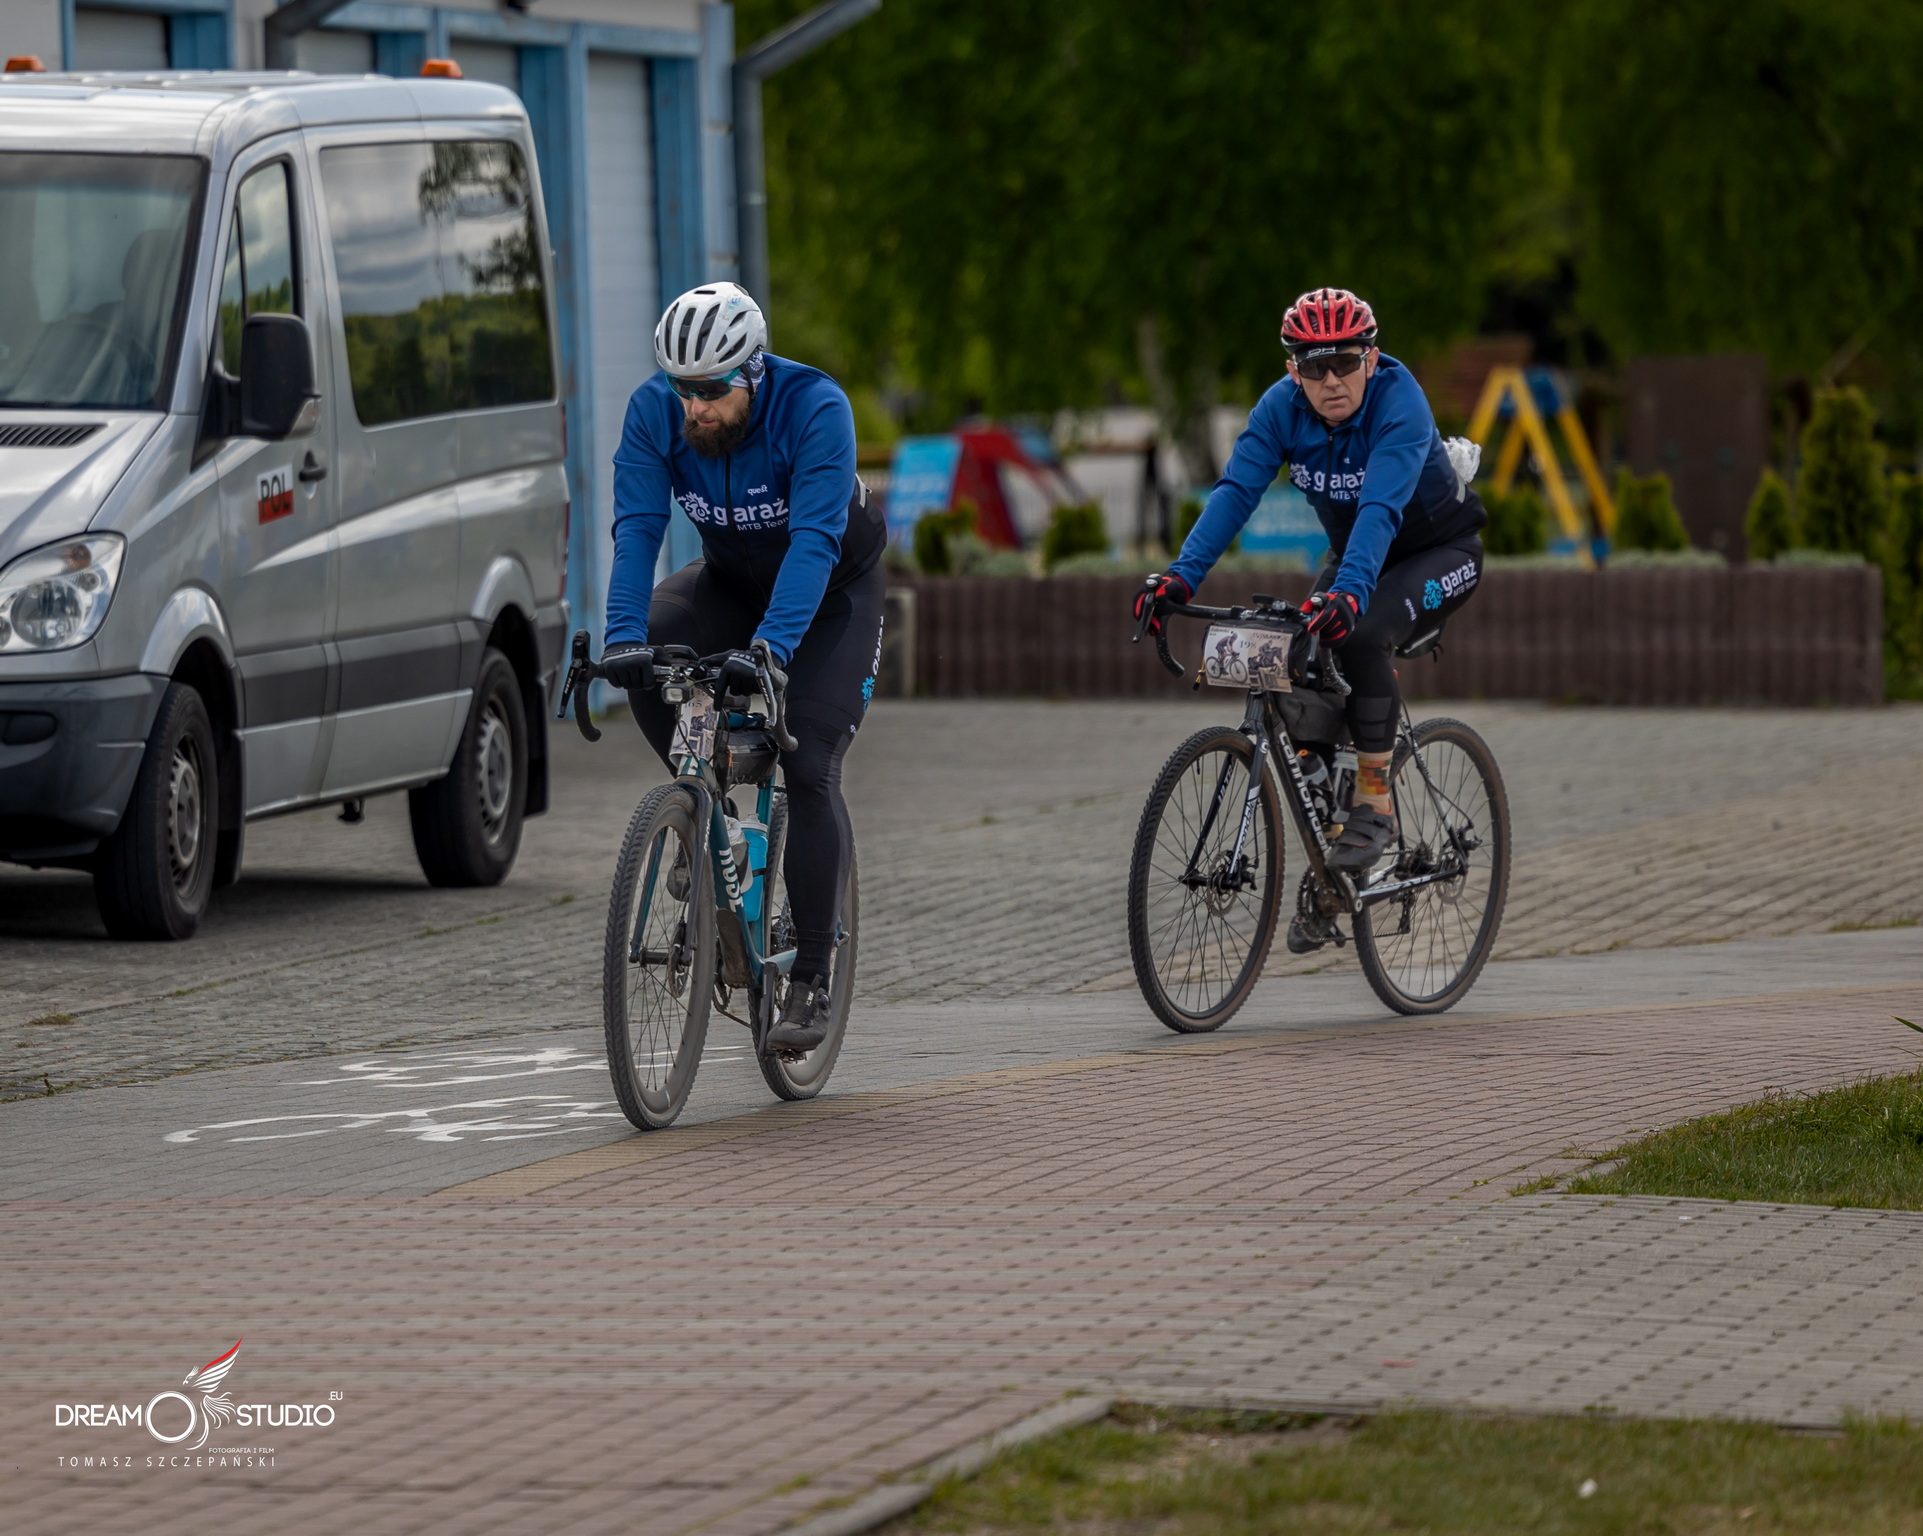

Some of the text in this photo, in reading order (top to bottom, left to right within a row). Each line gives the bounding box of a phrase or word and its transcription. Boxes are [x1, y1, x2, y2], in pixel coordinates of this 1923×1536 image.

[260, 472, 291, 518] POL
[1330, 490, 1351, 500] MTB
[713, 498, 789, 526] garaż
[737, 522, 762, 531] MTB
[1441, 559, 1477, 598] garaż
[1279, 731, 1330, 853] cannondal
